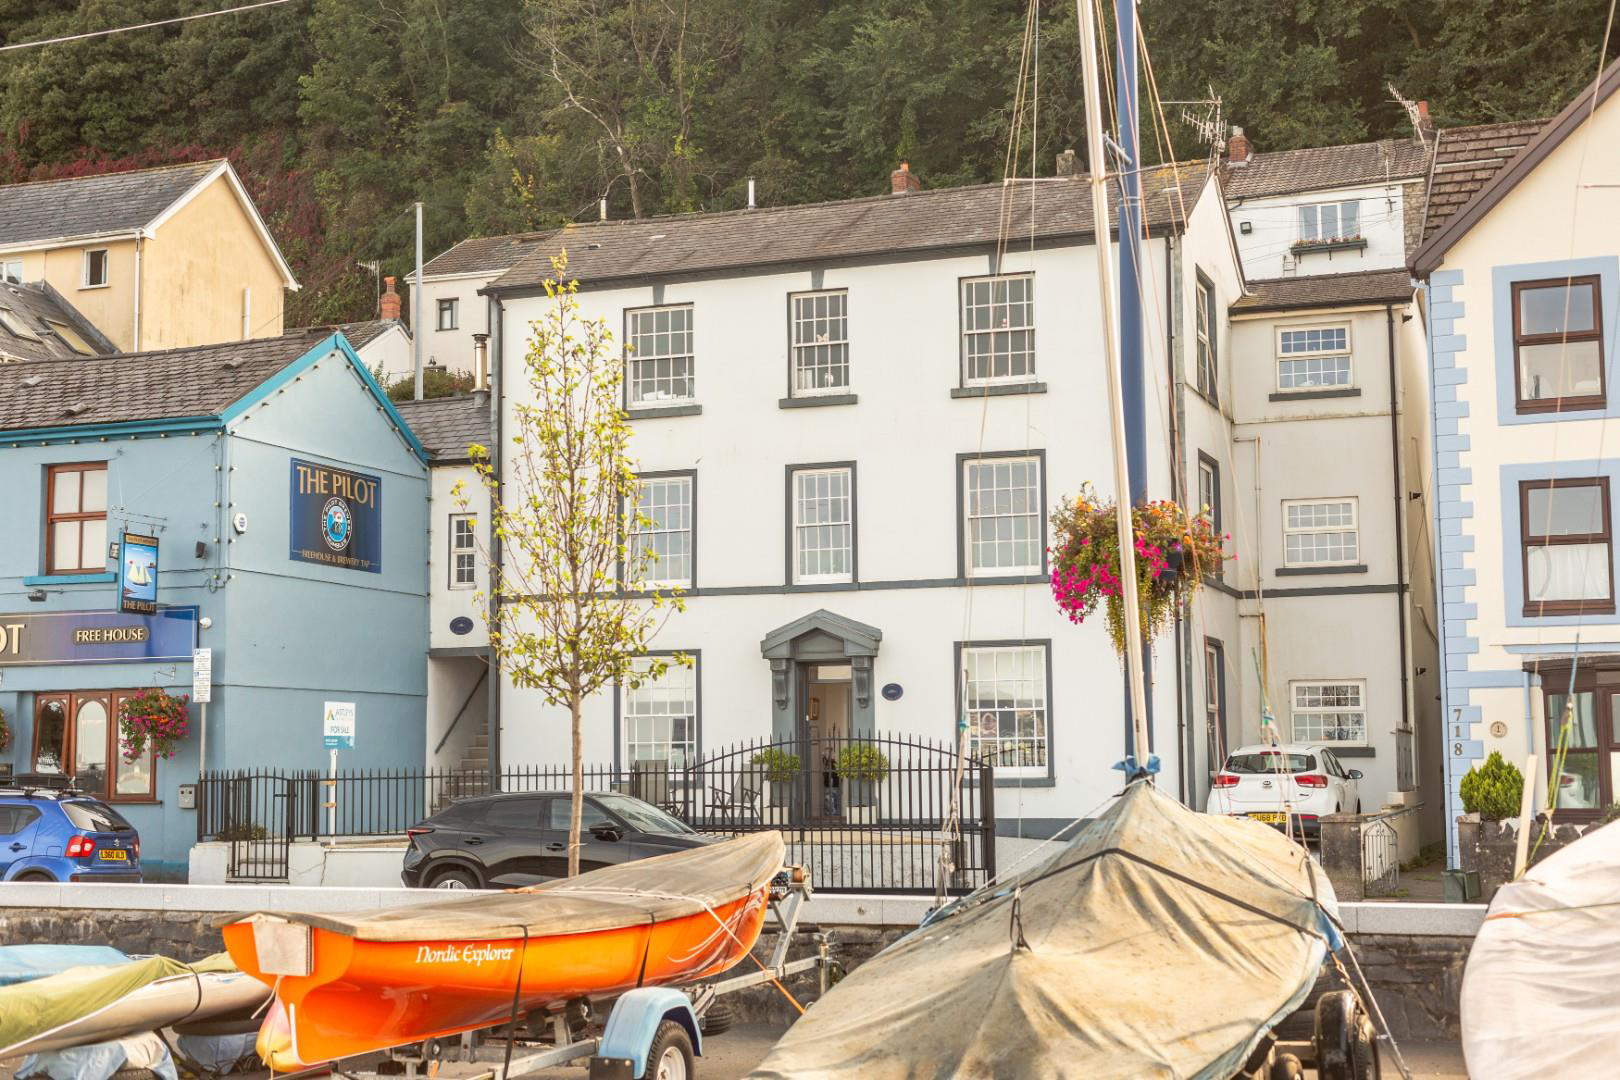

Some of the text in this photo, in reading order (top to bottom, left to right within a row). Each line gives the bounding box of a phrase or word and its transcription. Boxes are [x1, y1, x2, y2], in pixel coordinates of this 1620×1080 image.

[296, 464, 377, 510] THE PILOT
[123, 599, 155, 613] THE PILOT
[76, 628, 144, 642] FREE HOUSE
[1453, 708, 1463, 756] 718
[416, 943, 515, 967] Nordic Explorer
